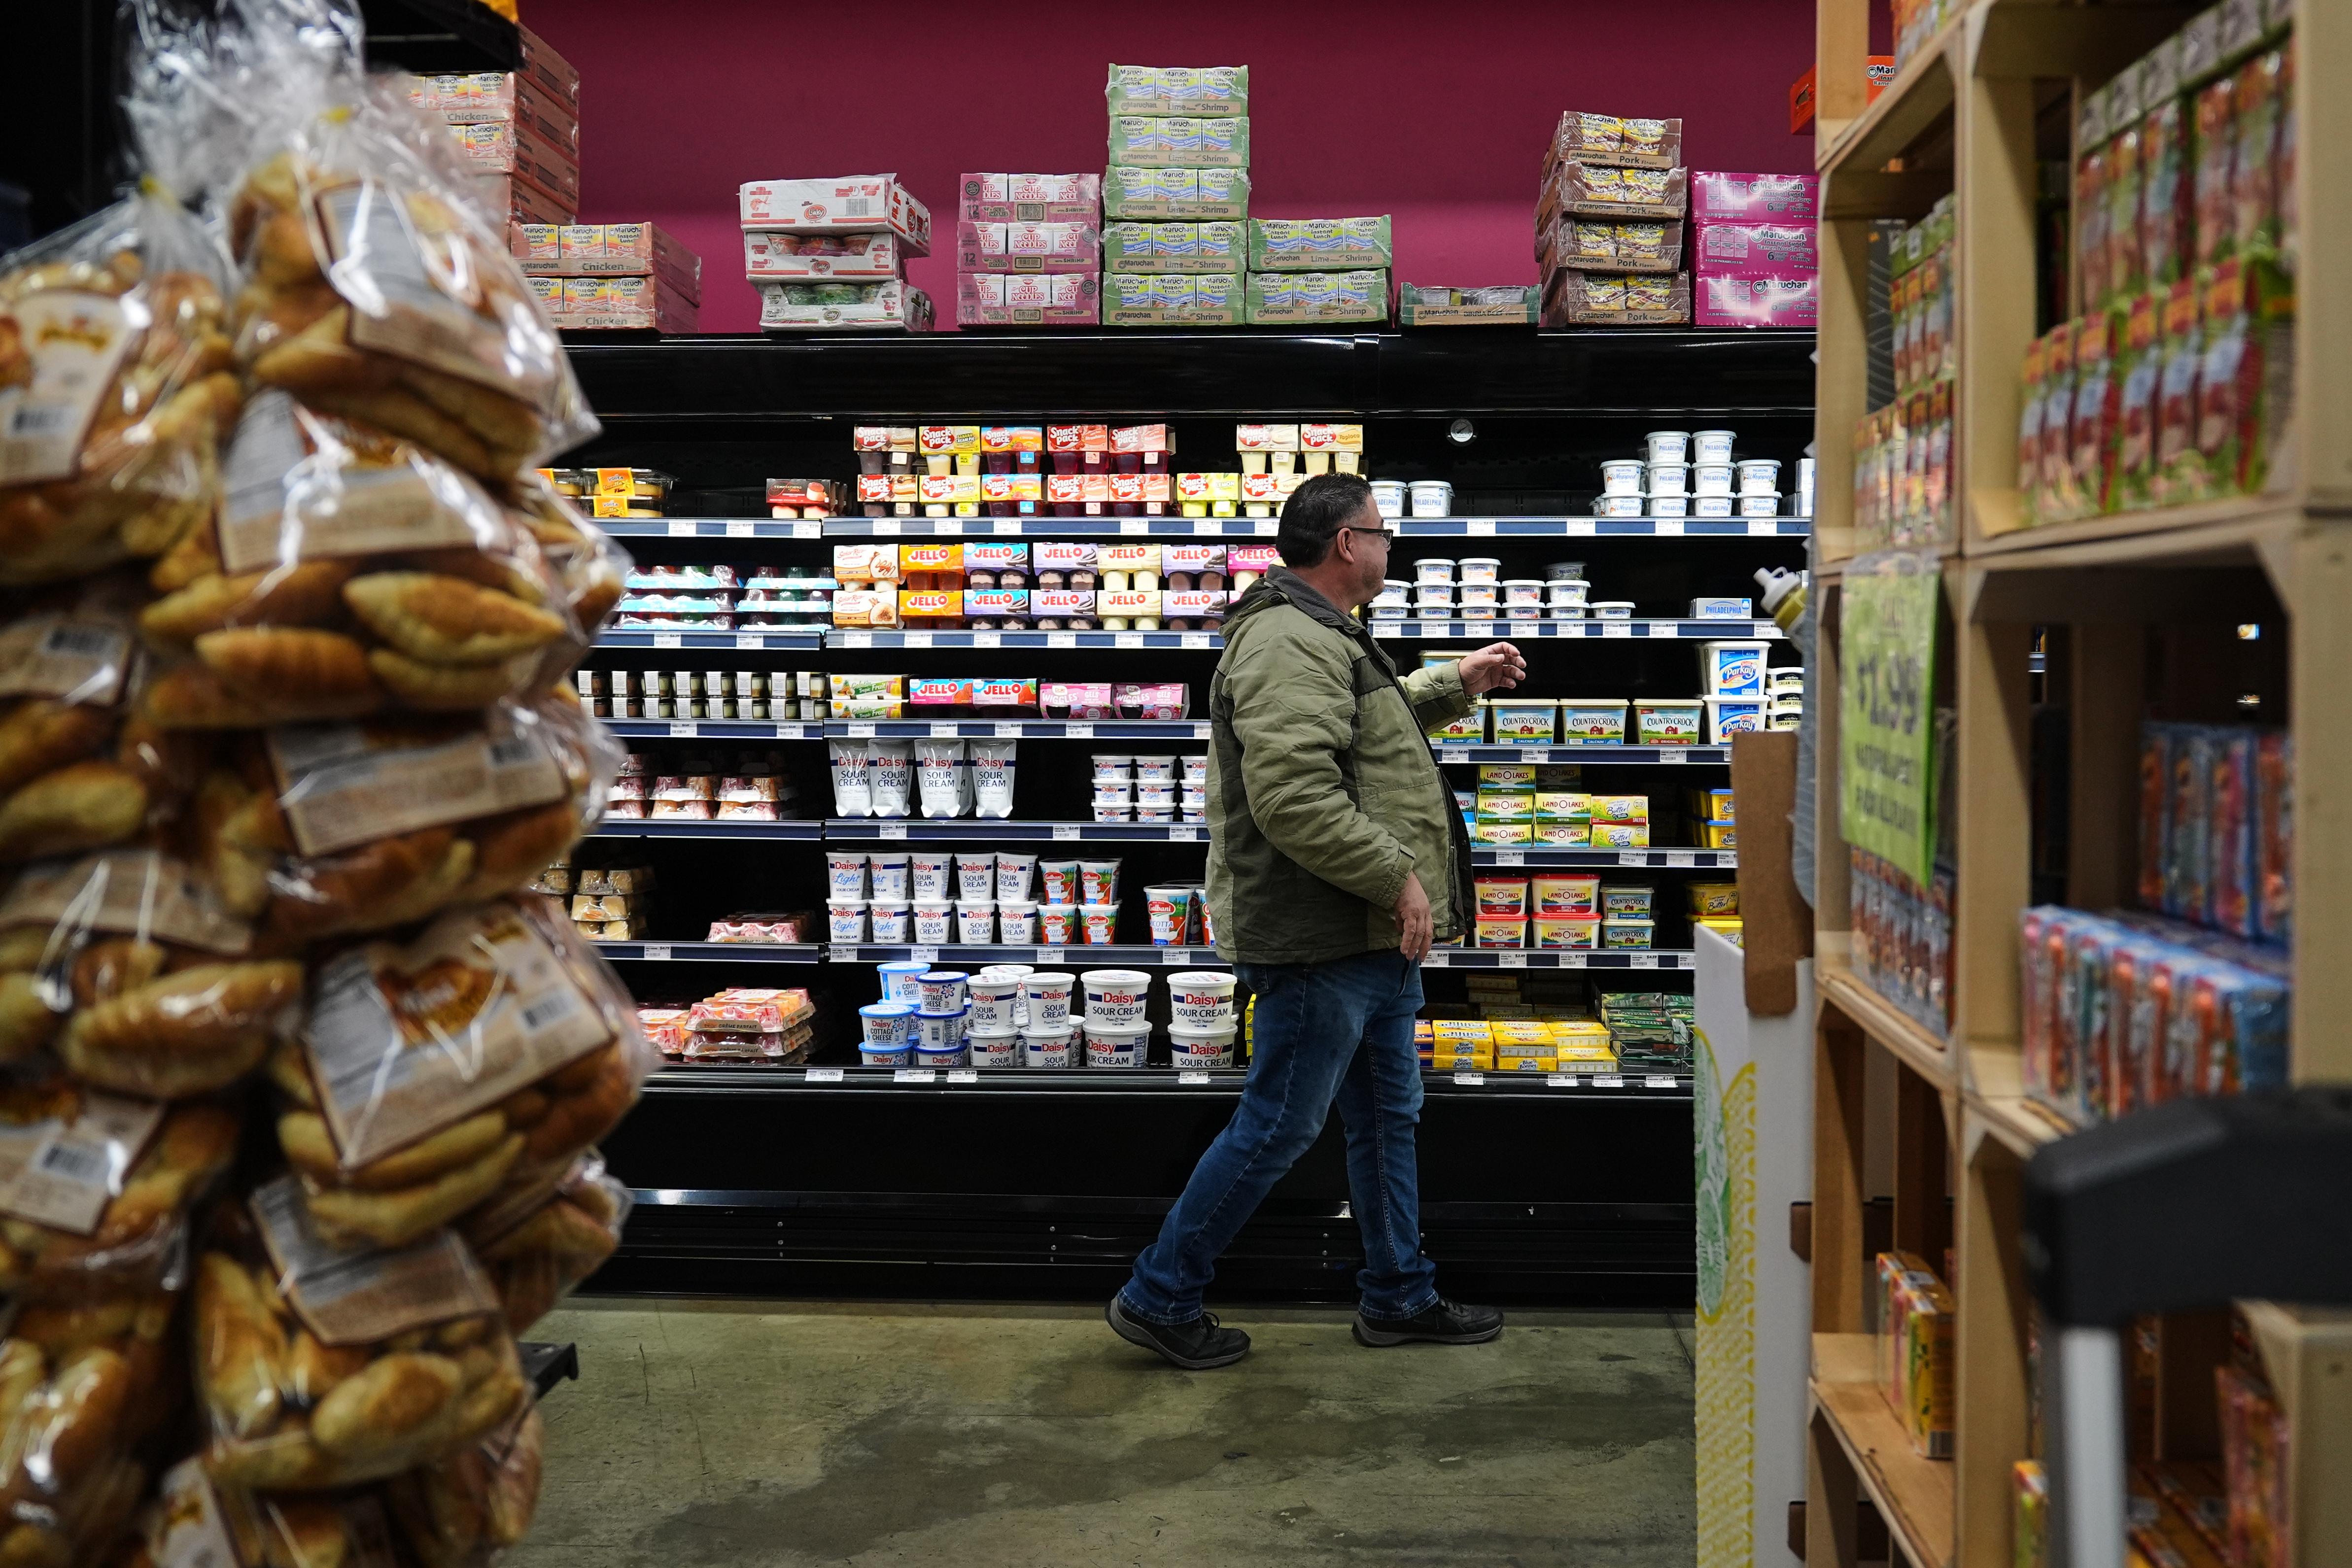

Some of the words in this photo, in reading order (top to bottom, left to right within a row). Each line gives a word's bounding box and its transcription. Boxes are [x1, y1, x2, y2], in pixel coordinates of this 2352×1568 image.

[1620, 156, 1640, 164] Pork
[1022, 185, 1040, 193] CUP
[1761, 182, 1803, 190] Maruchan
[1762, 230, 1804, 240] Maruchan
[964, 253, 975, 262] 12
[1767, 252, 1774, 260] 6
[583, 262, 623, 271] Chicken
[586, 317, 627, 325] Chicken
[923, 428, 951, 440] Snack
[1050, 426, 1078, 437] Snack
[1304, 427, 1333, 438] Snack
[861, 477, 889, 488] Snack
[1111, 477, 1141, 488] Snack
[1180, 477, 1206, 487] Snack
[1706, 606, 1741, 614] PHILADELPHIA
[1726, 665, 1754, 679] Parkay
[1042, 692, 1077, 704] WIGGLES
[1503, 717, 1528, 726] COUNTRY
[1529, 717, 1549, 726] CROCK
[1647, 717, 1673, 726] COUNTRY
[878, 757, 906, 768] Daisy
[878, 779, 907, 787] CREAM
[835, 862, 859, 871] Daisy
[834, 873, 861, 885] Light
[1148, 904, 1171, 912] Galbani
[919, 911, 942, 919] Daisy
[1042, 991, 1066, 1000] Daisy
[1104, 992, 1135, 1005] Daisy
[1186, 993, 1218, 1007] Daisy
[1093, 1007, 1114, 1016] SOUR
[1117, 1007, 1143, 1016] CREAM
[1176, 1008, 1197, 1017] SOUR
[1199, 1008, 1228, 1017] CREAM
[1190, 1044, 1222, 1057] Daisy
[1180, 1058, 1203, 1066] SOUR
[1205, 1057, 1231, 1066] CREAM
